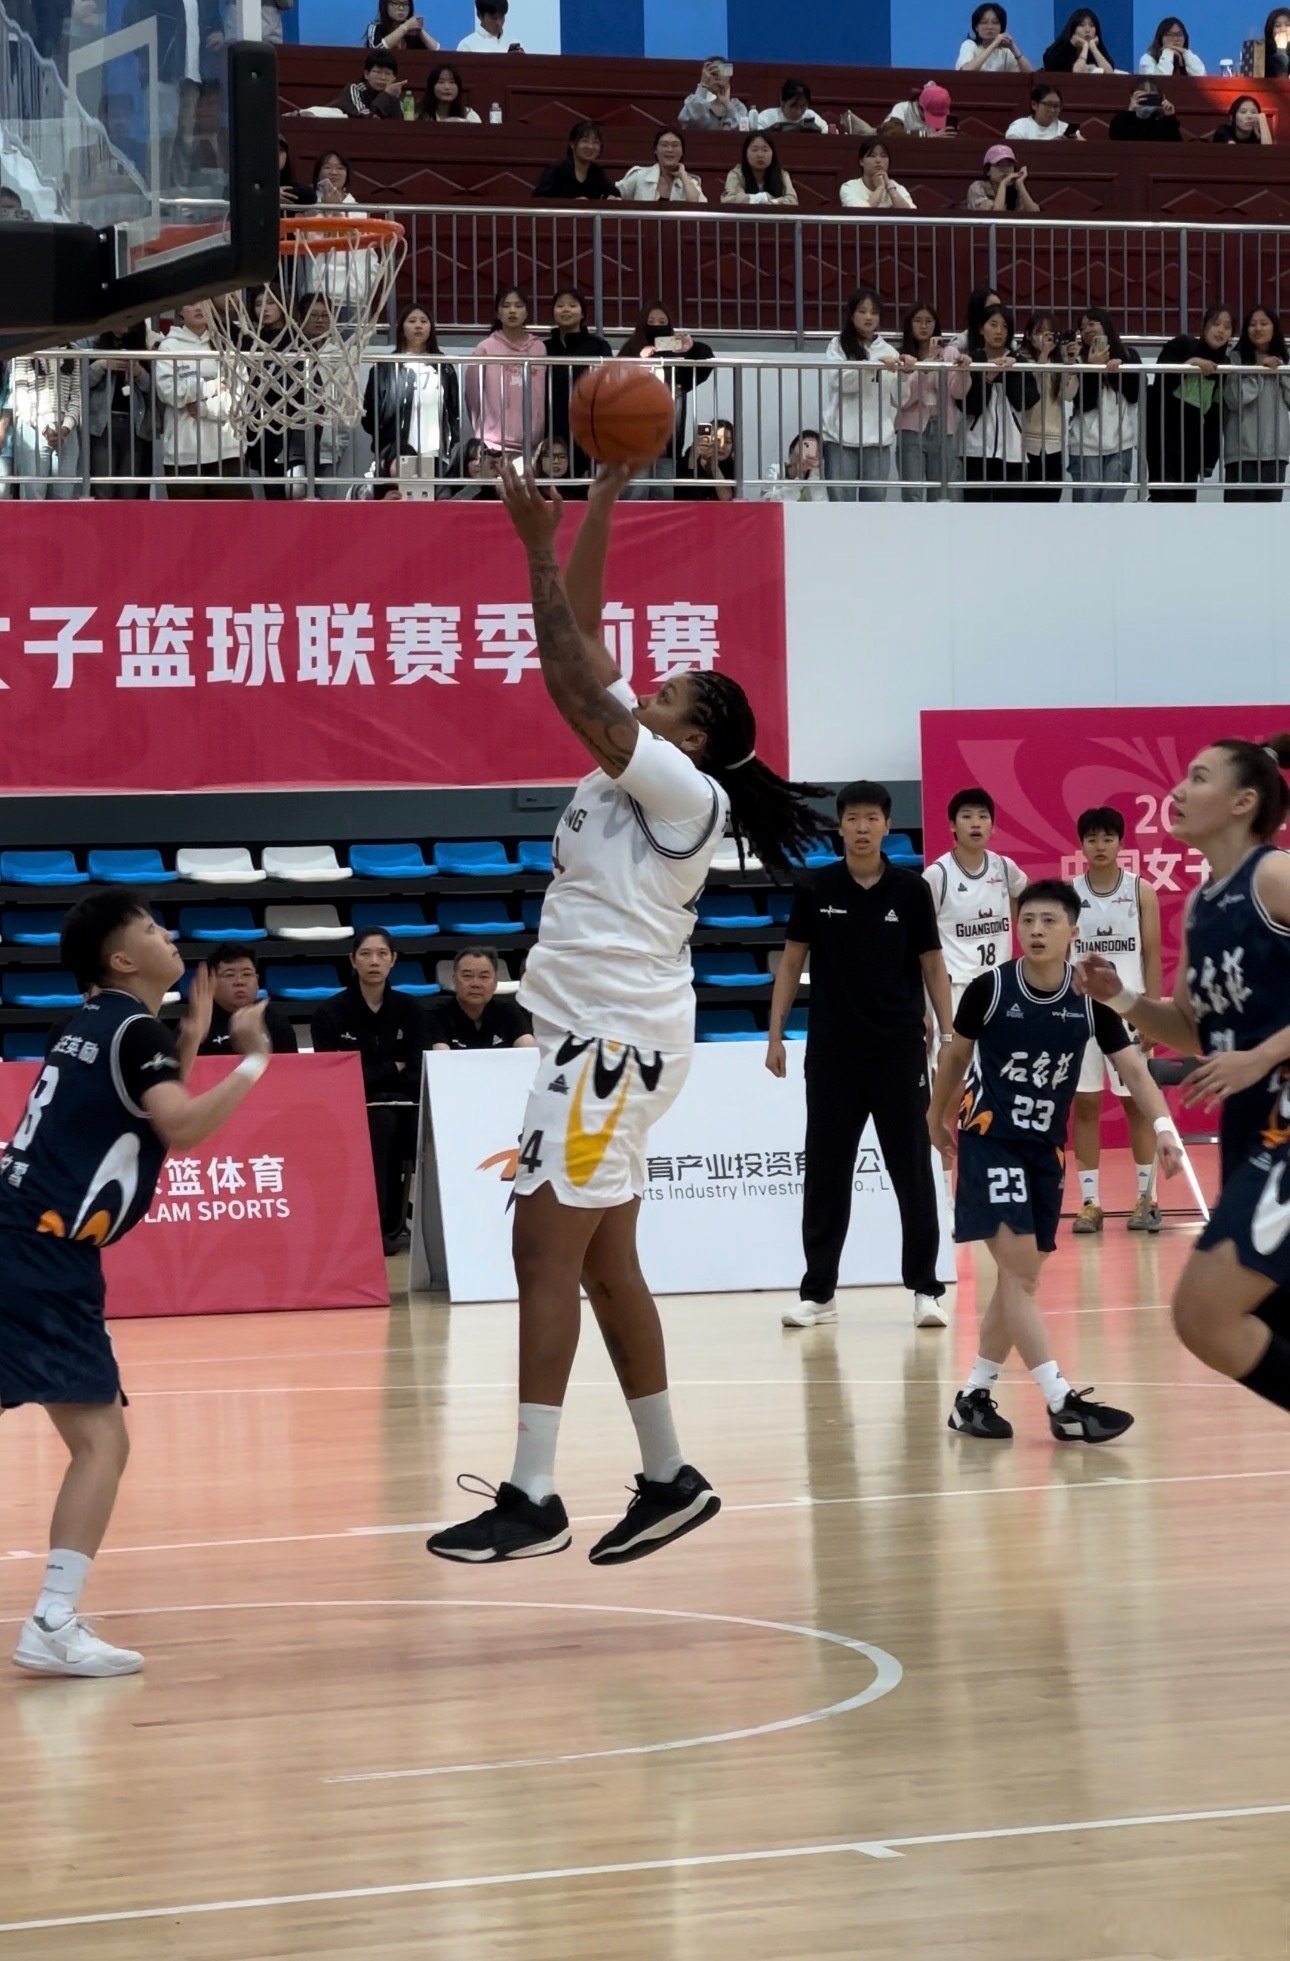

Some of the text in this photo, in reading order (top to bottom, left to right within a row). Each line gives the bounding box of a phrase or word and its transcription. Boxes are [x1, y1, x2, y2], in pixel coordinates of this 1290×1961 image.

[0, 603, 721, 689] 子篮球联赛季赛
[977, 942, 996, 967] 18
[1011, 1095, 1056, 1132] 23
[155, 1154, 285, 1196] 篮体育
[669, 1182, 737, 1201] Industry
[987, 1167, 1028, 1203] 23
[139, 1197, 290, 1224] LAM SPORTS
